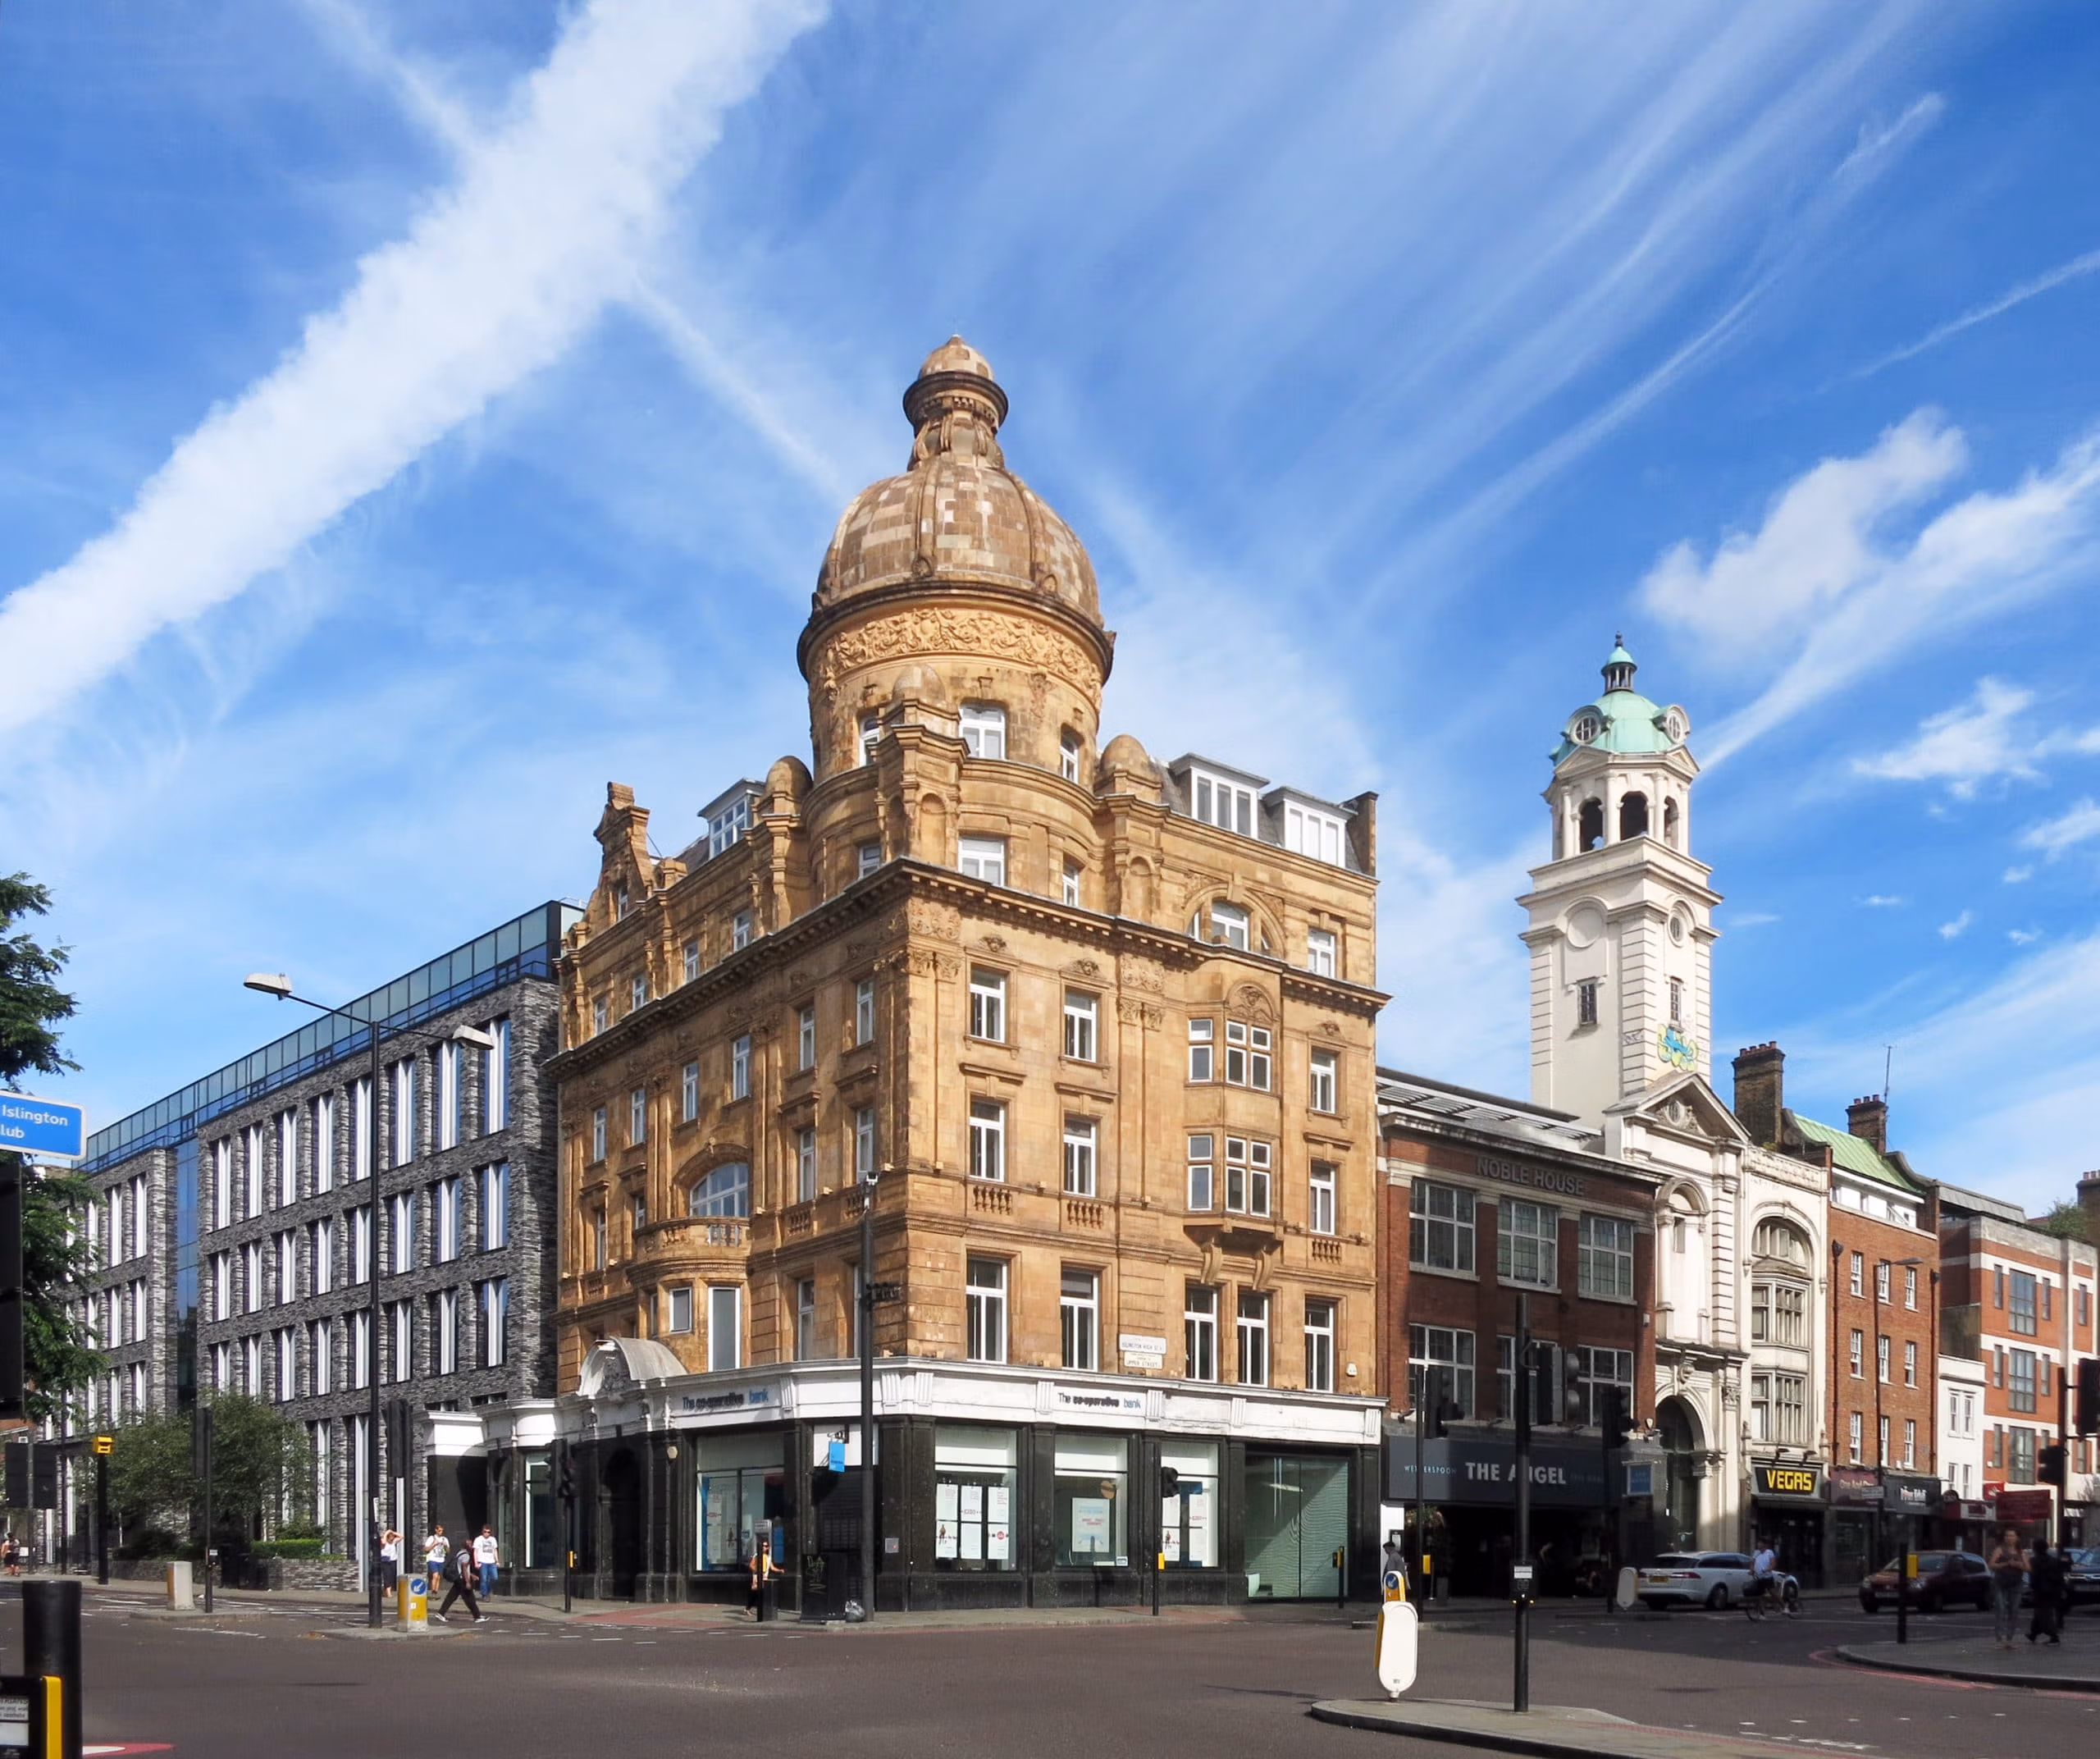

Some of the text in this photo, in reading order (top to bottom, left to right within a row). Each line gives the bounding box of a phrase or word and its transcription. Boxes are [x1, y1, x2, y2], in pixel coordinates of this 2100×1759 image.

[2, 1104, 68, 1126] Islington
[1477, 1157, 1585, 1195] NOBLE HOUSE
[1058, 1393, 1071, 1404] The
[1124, 1398, 1141, 1409] bank
[1404, 1464, 1456, 1474] WETERSPOON
[1465, 1462, 1500, 1481] THE
[1766, 1469, 1812, 1491] VEGAS
